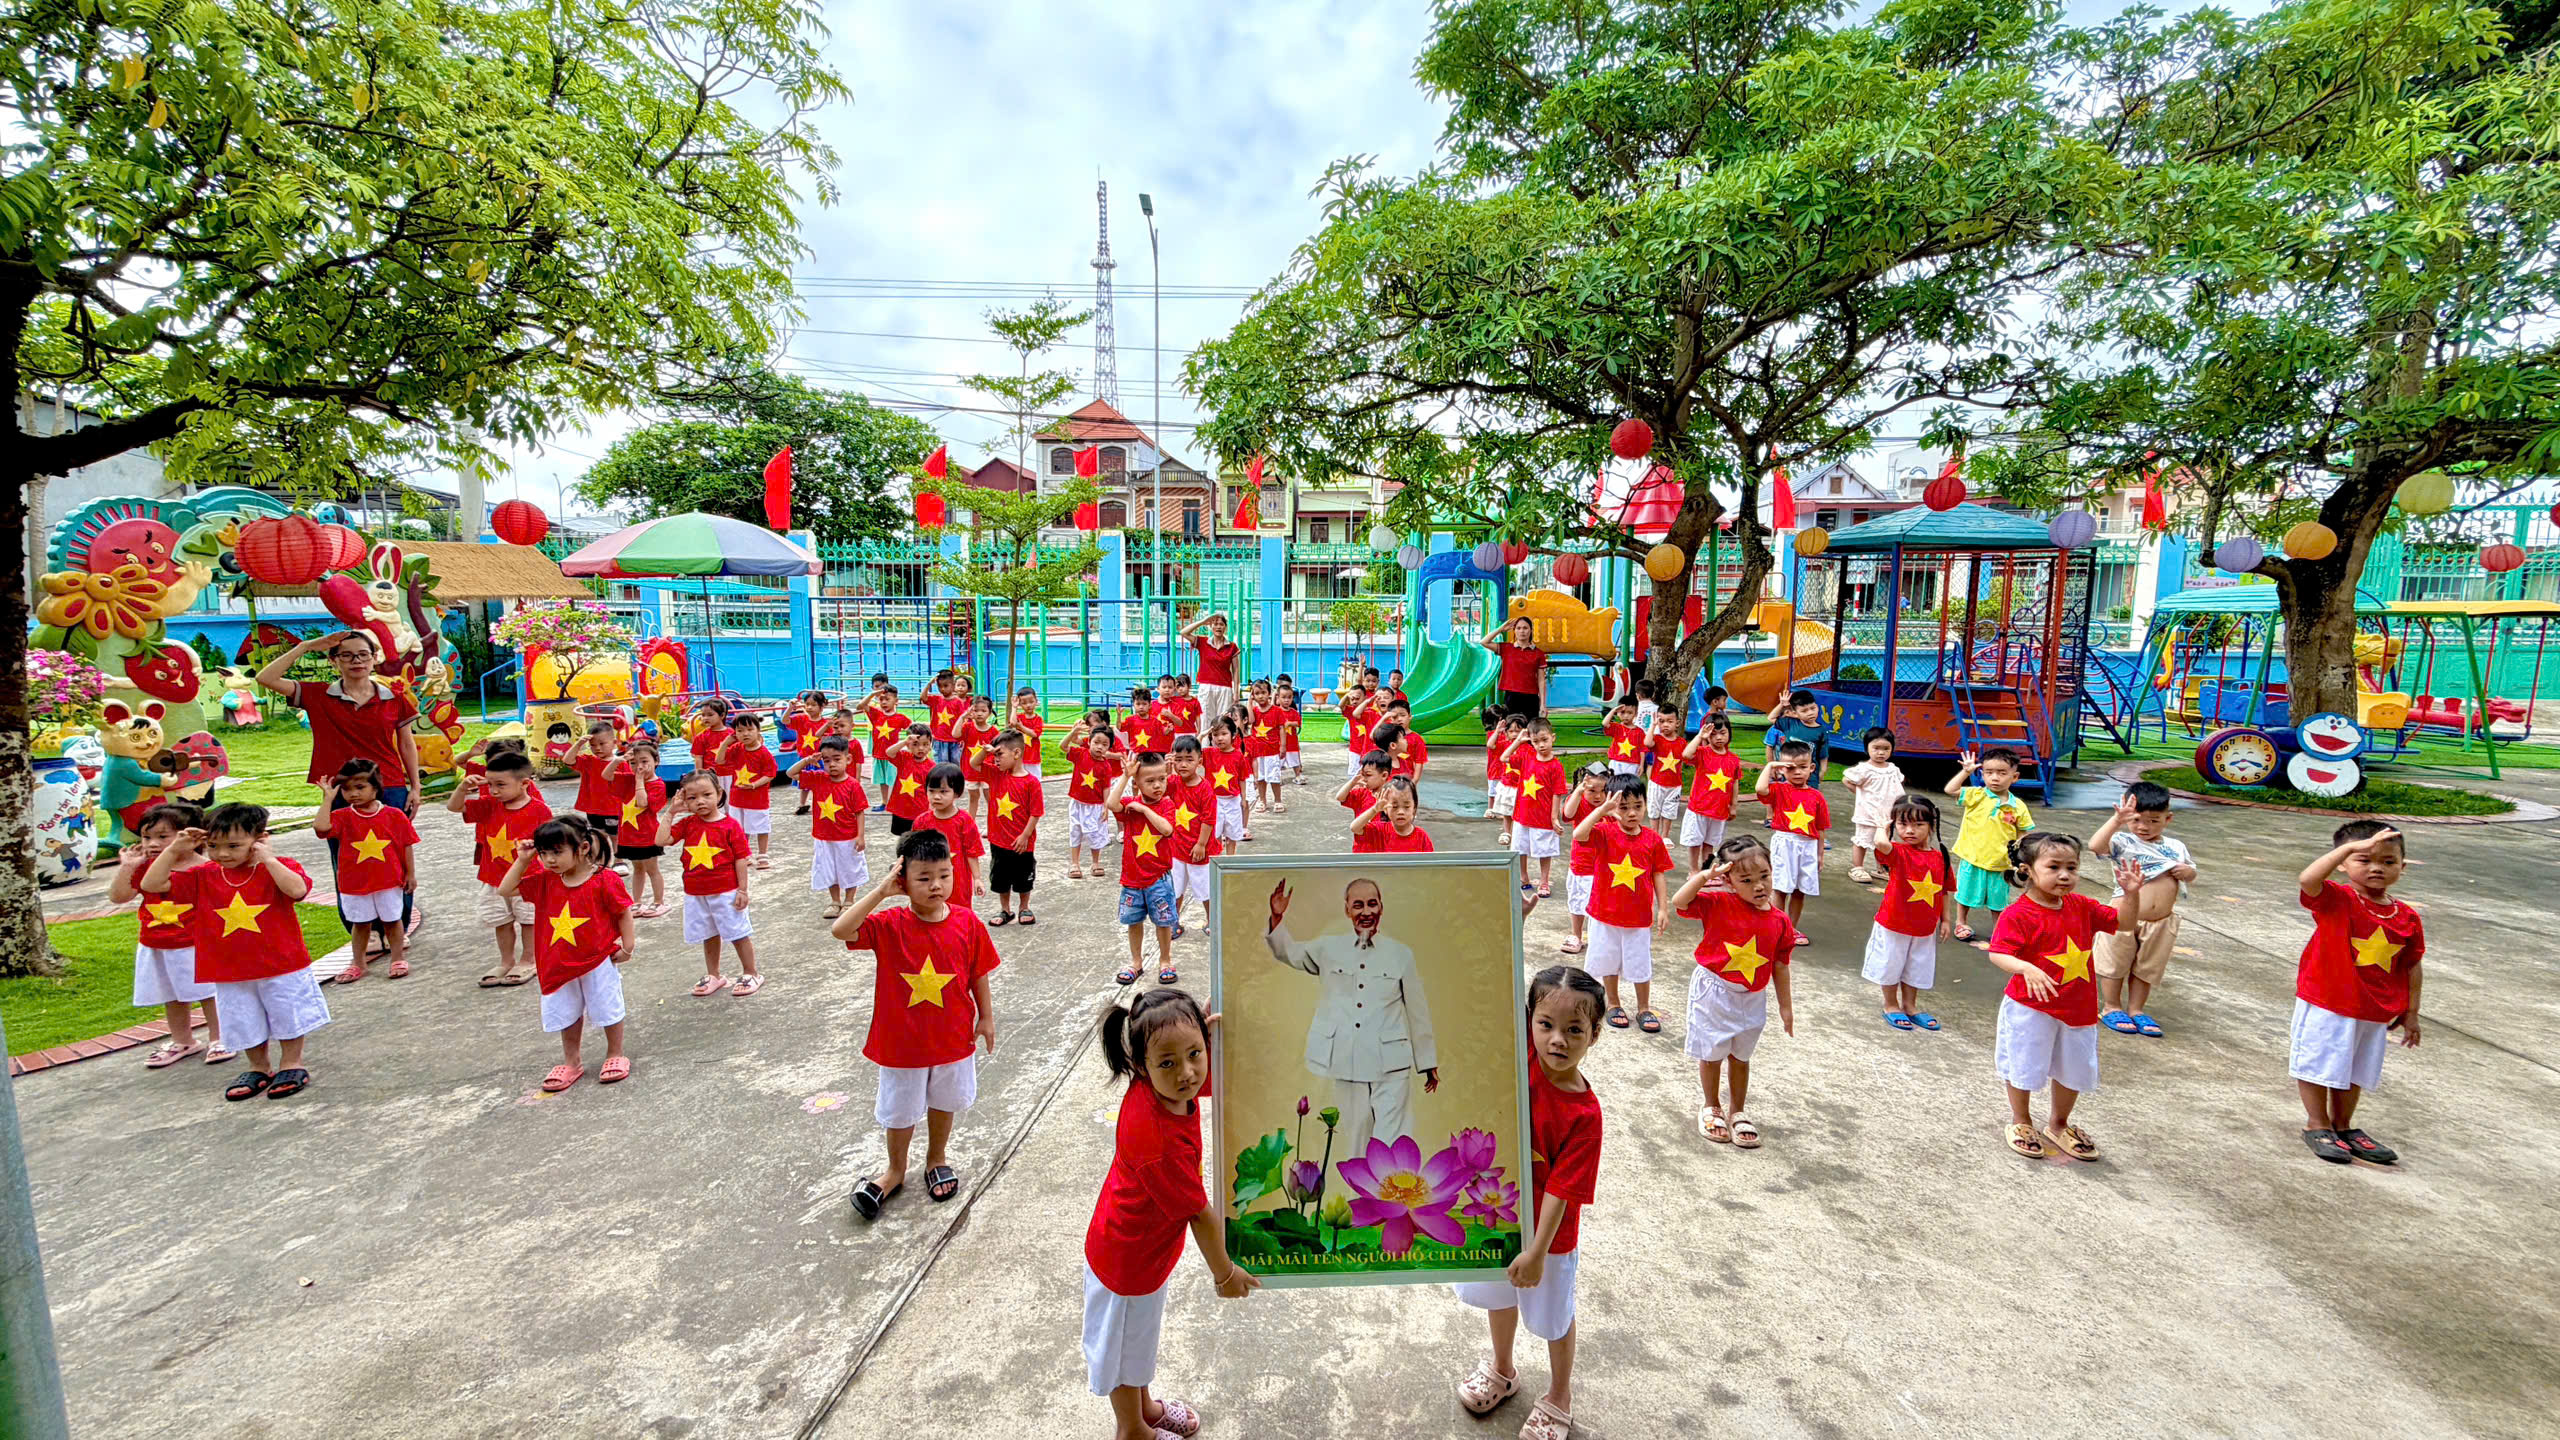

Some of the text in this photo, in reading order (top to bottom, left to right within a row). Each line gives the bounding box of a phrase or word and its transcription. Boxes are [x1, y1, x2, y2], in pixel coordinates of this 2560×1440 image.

[2215, 753, 2222, 761] 9
[2265, 753, 2272, 762] 3
[2219, 764, 2225, 772] 8
[1241, 1252, 1272, 1266] MÃI
[1277, 1251, 1308, 1265] MÃI
[1461, 1248, 1503, 1261] MINH
